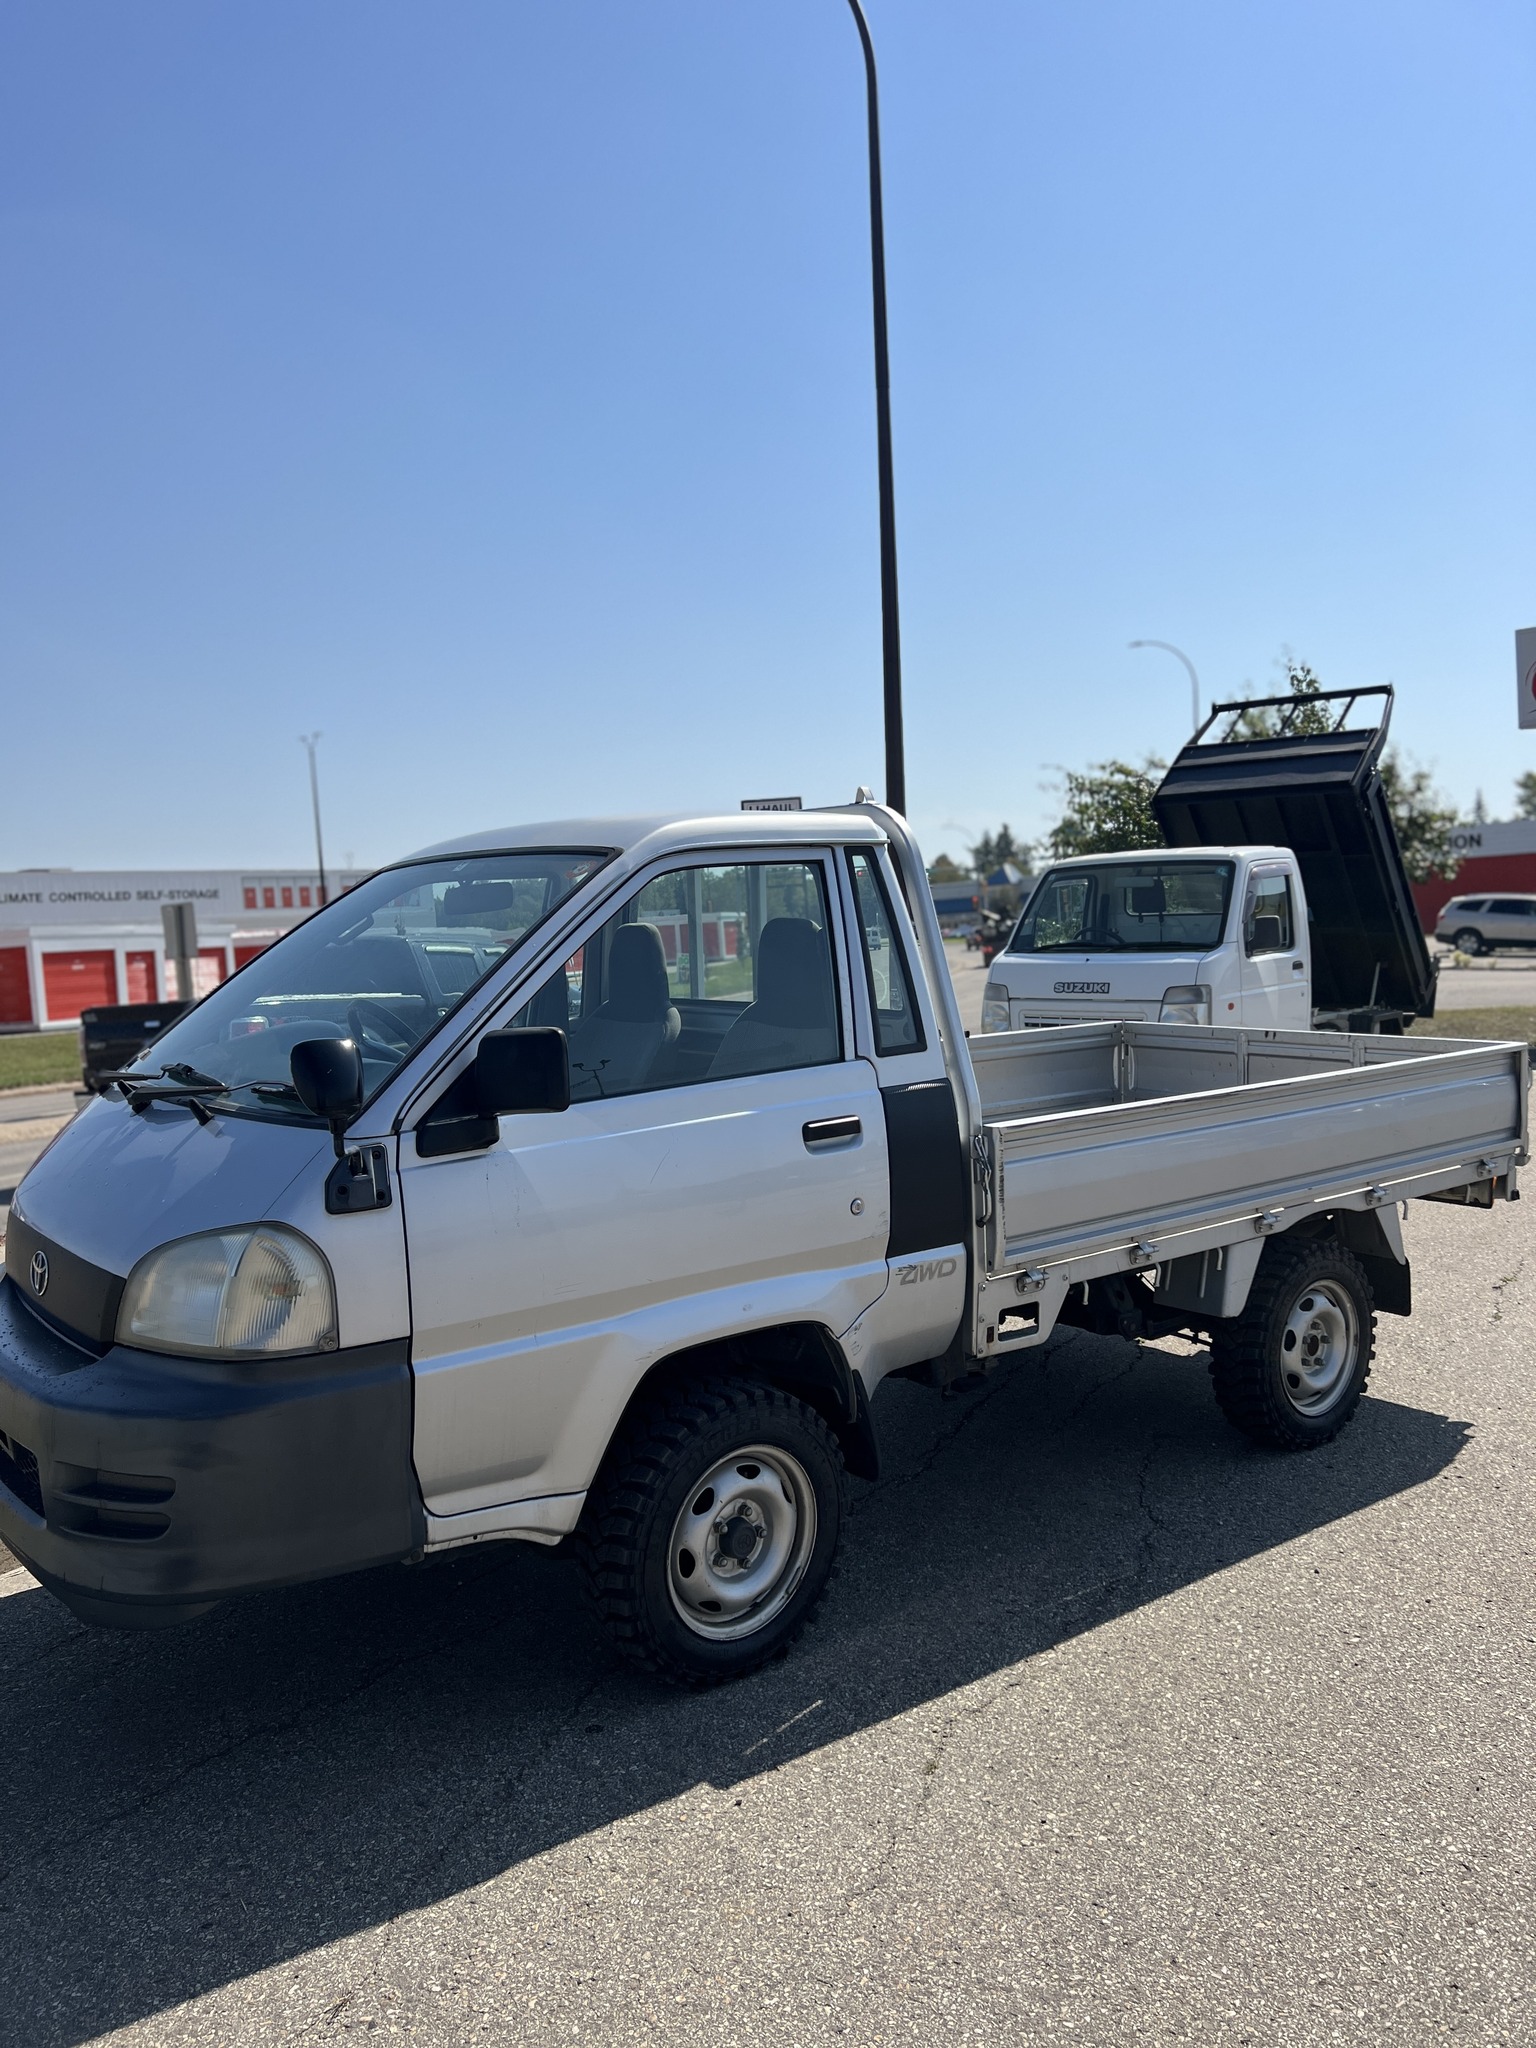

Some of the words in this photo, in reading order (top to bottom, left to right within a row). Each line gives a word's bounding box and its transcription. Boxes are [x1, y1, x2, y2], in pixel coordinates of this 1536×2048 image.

[48, 890, 131, 903] CONTROLLED
[136, 888, 220, 901] SELF-STORAGE
[1053, 982, 1110, 994] SUZUKI
